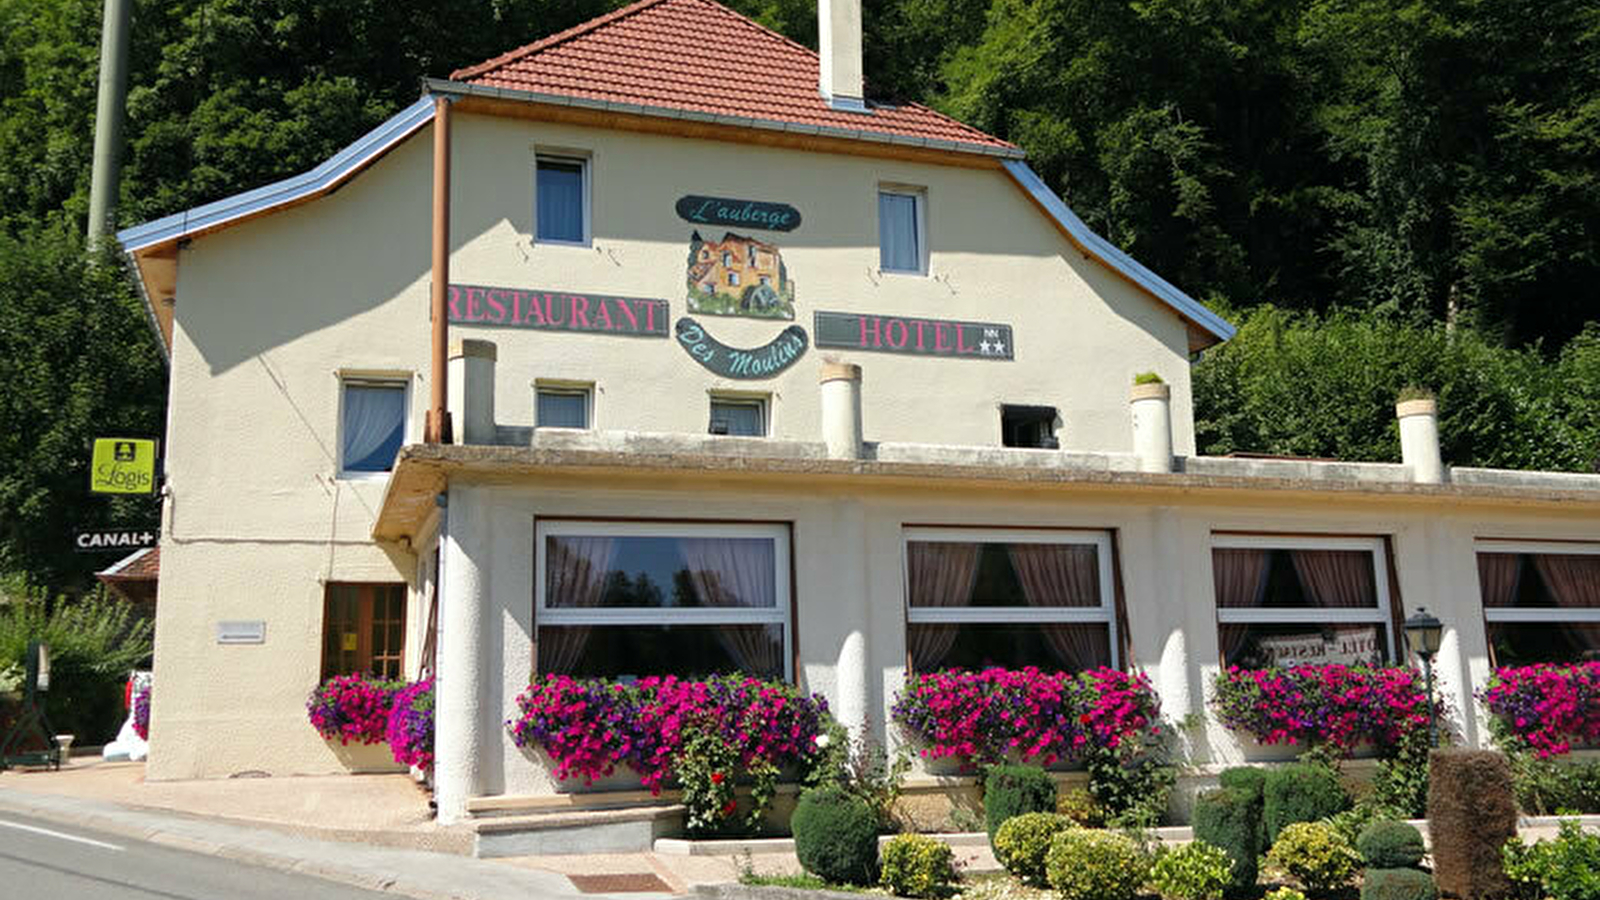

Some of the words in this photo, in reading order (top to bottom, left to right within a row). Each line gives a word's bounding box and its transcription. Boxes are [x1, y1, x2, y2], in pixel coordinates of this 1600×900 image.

[689, 200, 791, 230] L'auberge
[448, 286, 662, 331] RESTAURANT
[680, 325, 715, 362] Des
[729, 335, 803, 375] Moulins
[859, 316, 975, 353] HOTEL
[96, 461, 150, 491] Logis
[77, 531, 154, 547] CANAL+
